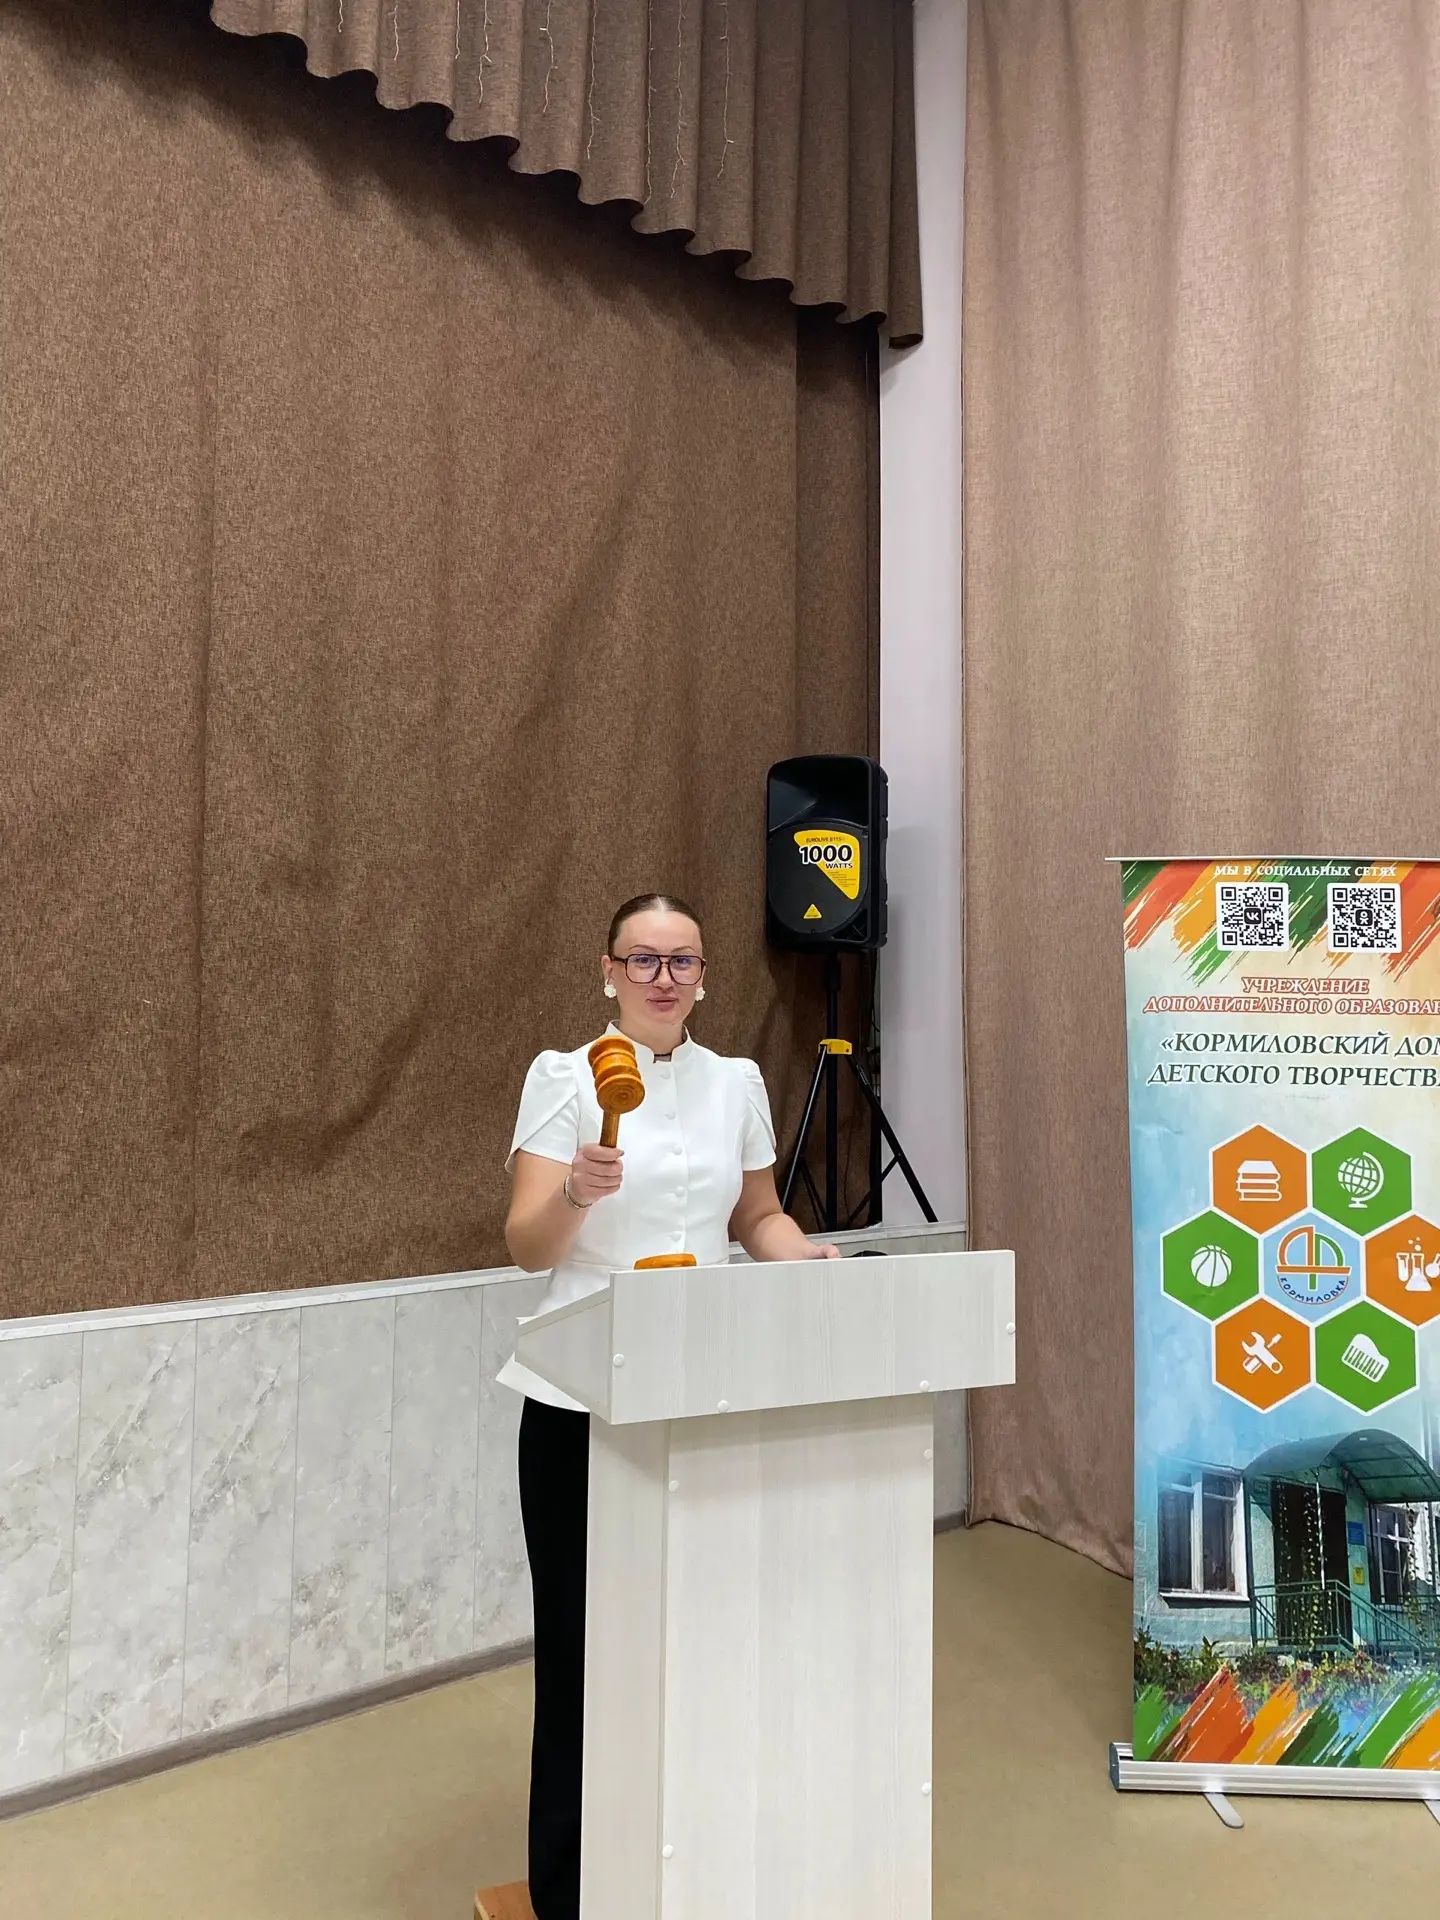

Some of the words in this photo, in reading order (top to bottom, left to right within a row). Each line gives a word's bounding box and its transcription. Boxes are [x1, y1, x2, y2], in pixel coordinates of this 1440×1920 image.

[799, 844, 853, 864] 1000
[1214, 865, 1238, 876] МЫ
[1243, 866, 1251, 875] В
[1257, 865, 1351, 877] СОЦИАЛЬНЫХ
[1355, 866, 1397, 877] СЕТЯХ
[1241, 977, 1369, 995] УЧРЕЖДЕНИЕ
[1142, 996, 1332, 1014] ДОПОЛНИТЕЛЬНОГО
[1161, 1031, 1391, 1055] «КОРМИЛОВСКИЙ
[1147, 1064, 1281, 1084] ДЕТСКОГО
[1288, 1066, 1440, 1087] ТВОРЧЕСТВ
[1280, 1277, 1346, 1303] КОРМИЛОВКА
